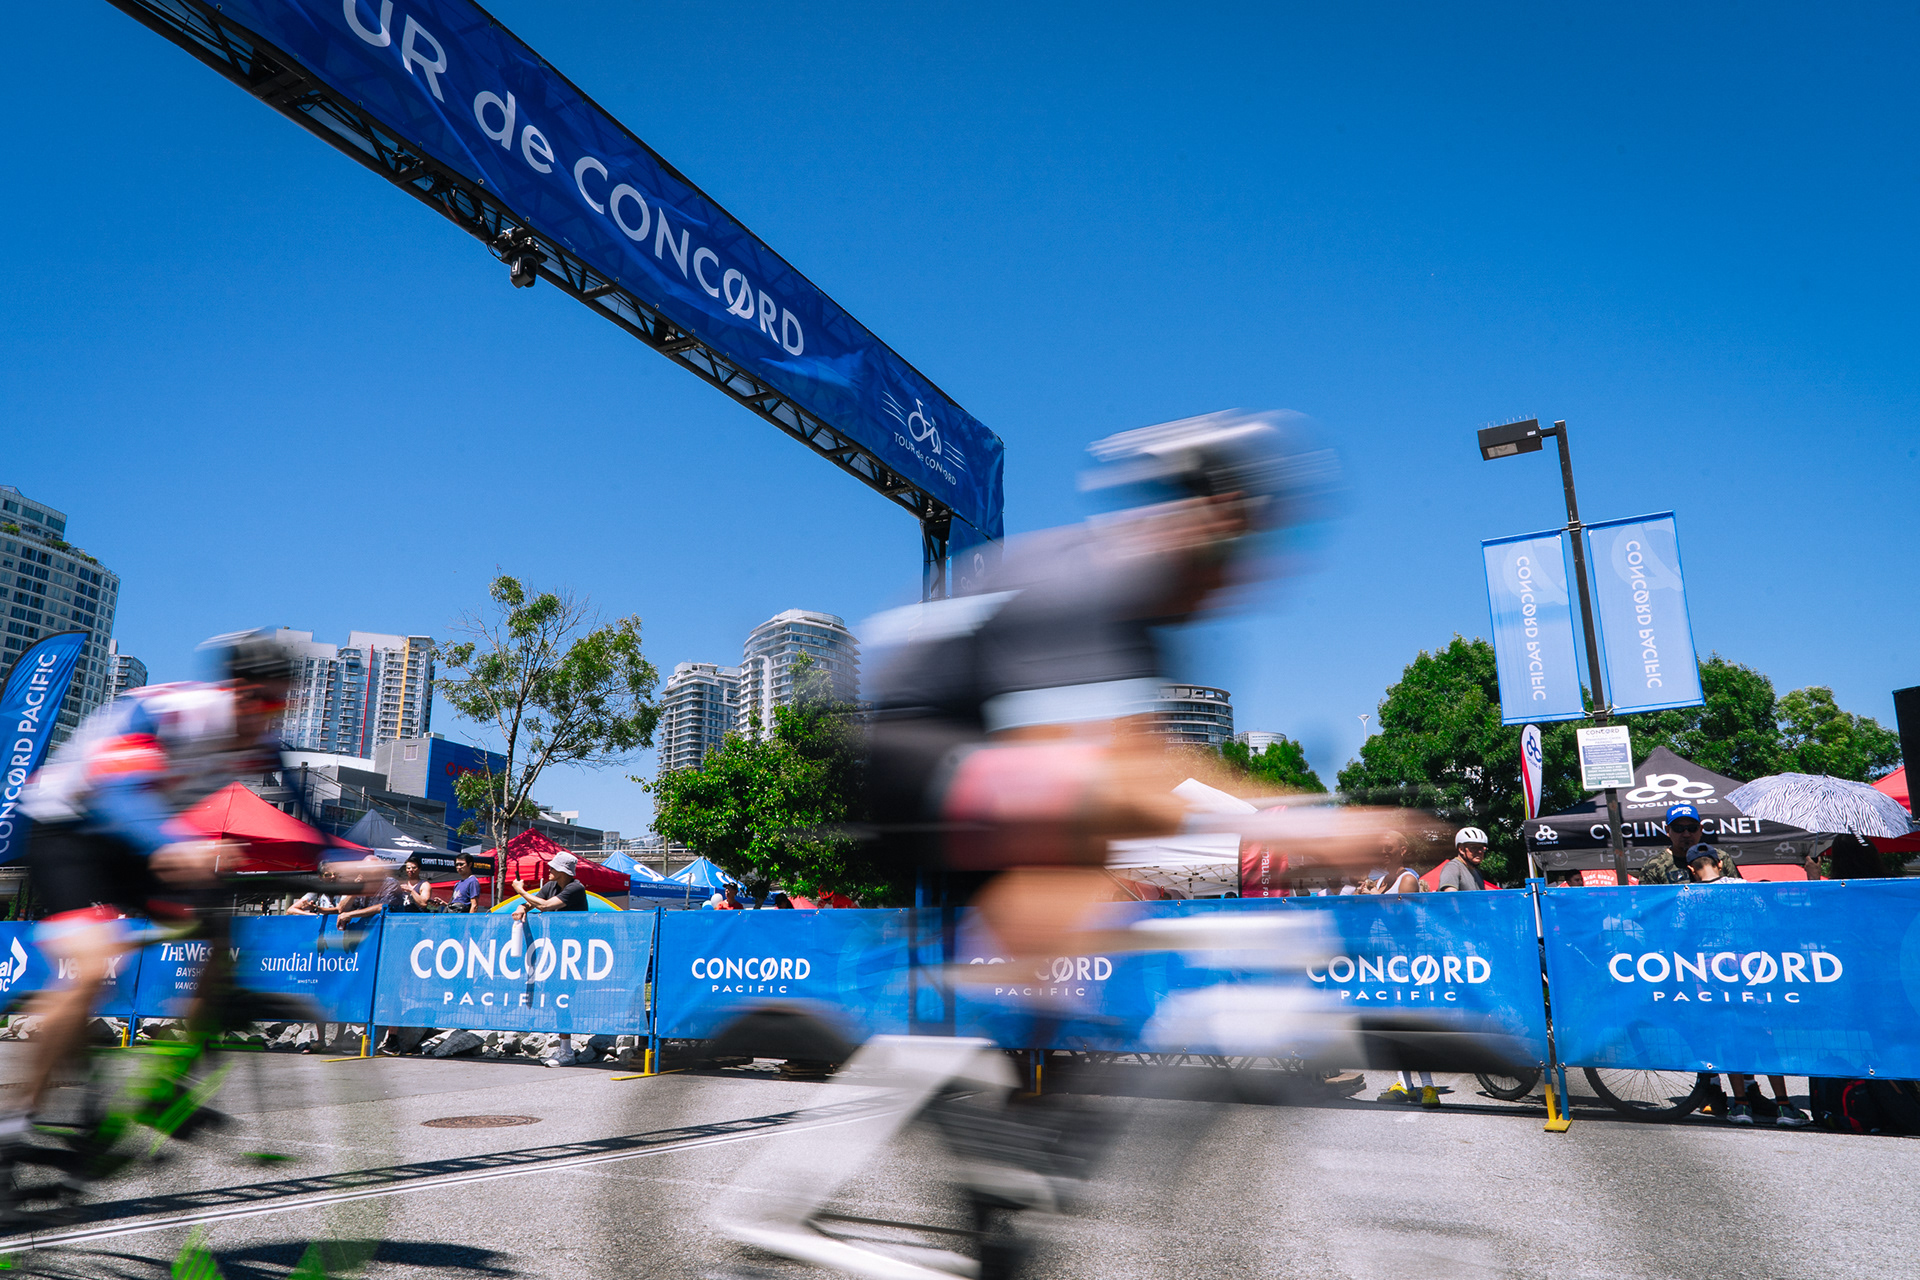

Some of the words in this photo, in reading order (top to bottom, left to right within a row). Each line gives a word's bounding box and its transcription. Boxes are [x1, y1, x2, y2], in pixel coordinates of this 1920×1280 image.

[473, 90, 554, 174] de
[894, 431, 916, 454] TOUR
[17, 653, 57, 733] PACIFIC
[1626, 800, 1692, 809] CYCLING
[260, 952, 312, 972] sundial
[711, 984, 788, 994] PACIFIC
[994, 987, 1086, 997] PACIFIC
[1340, 990, 1457, 1002] PACIFIC
[443, 991, 570, 1009] PACIFIC
[1653, 991, 1800, 1003] PACIFIC
